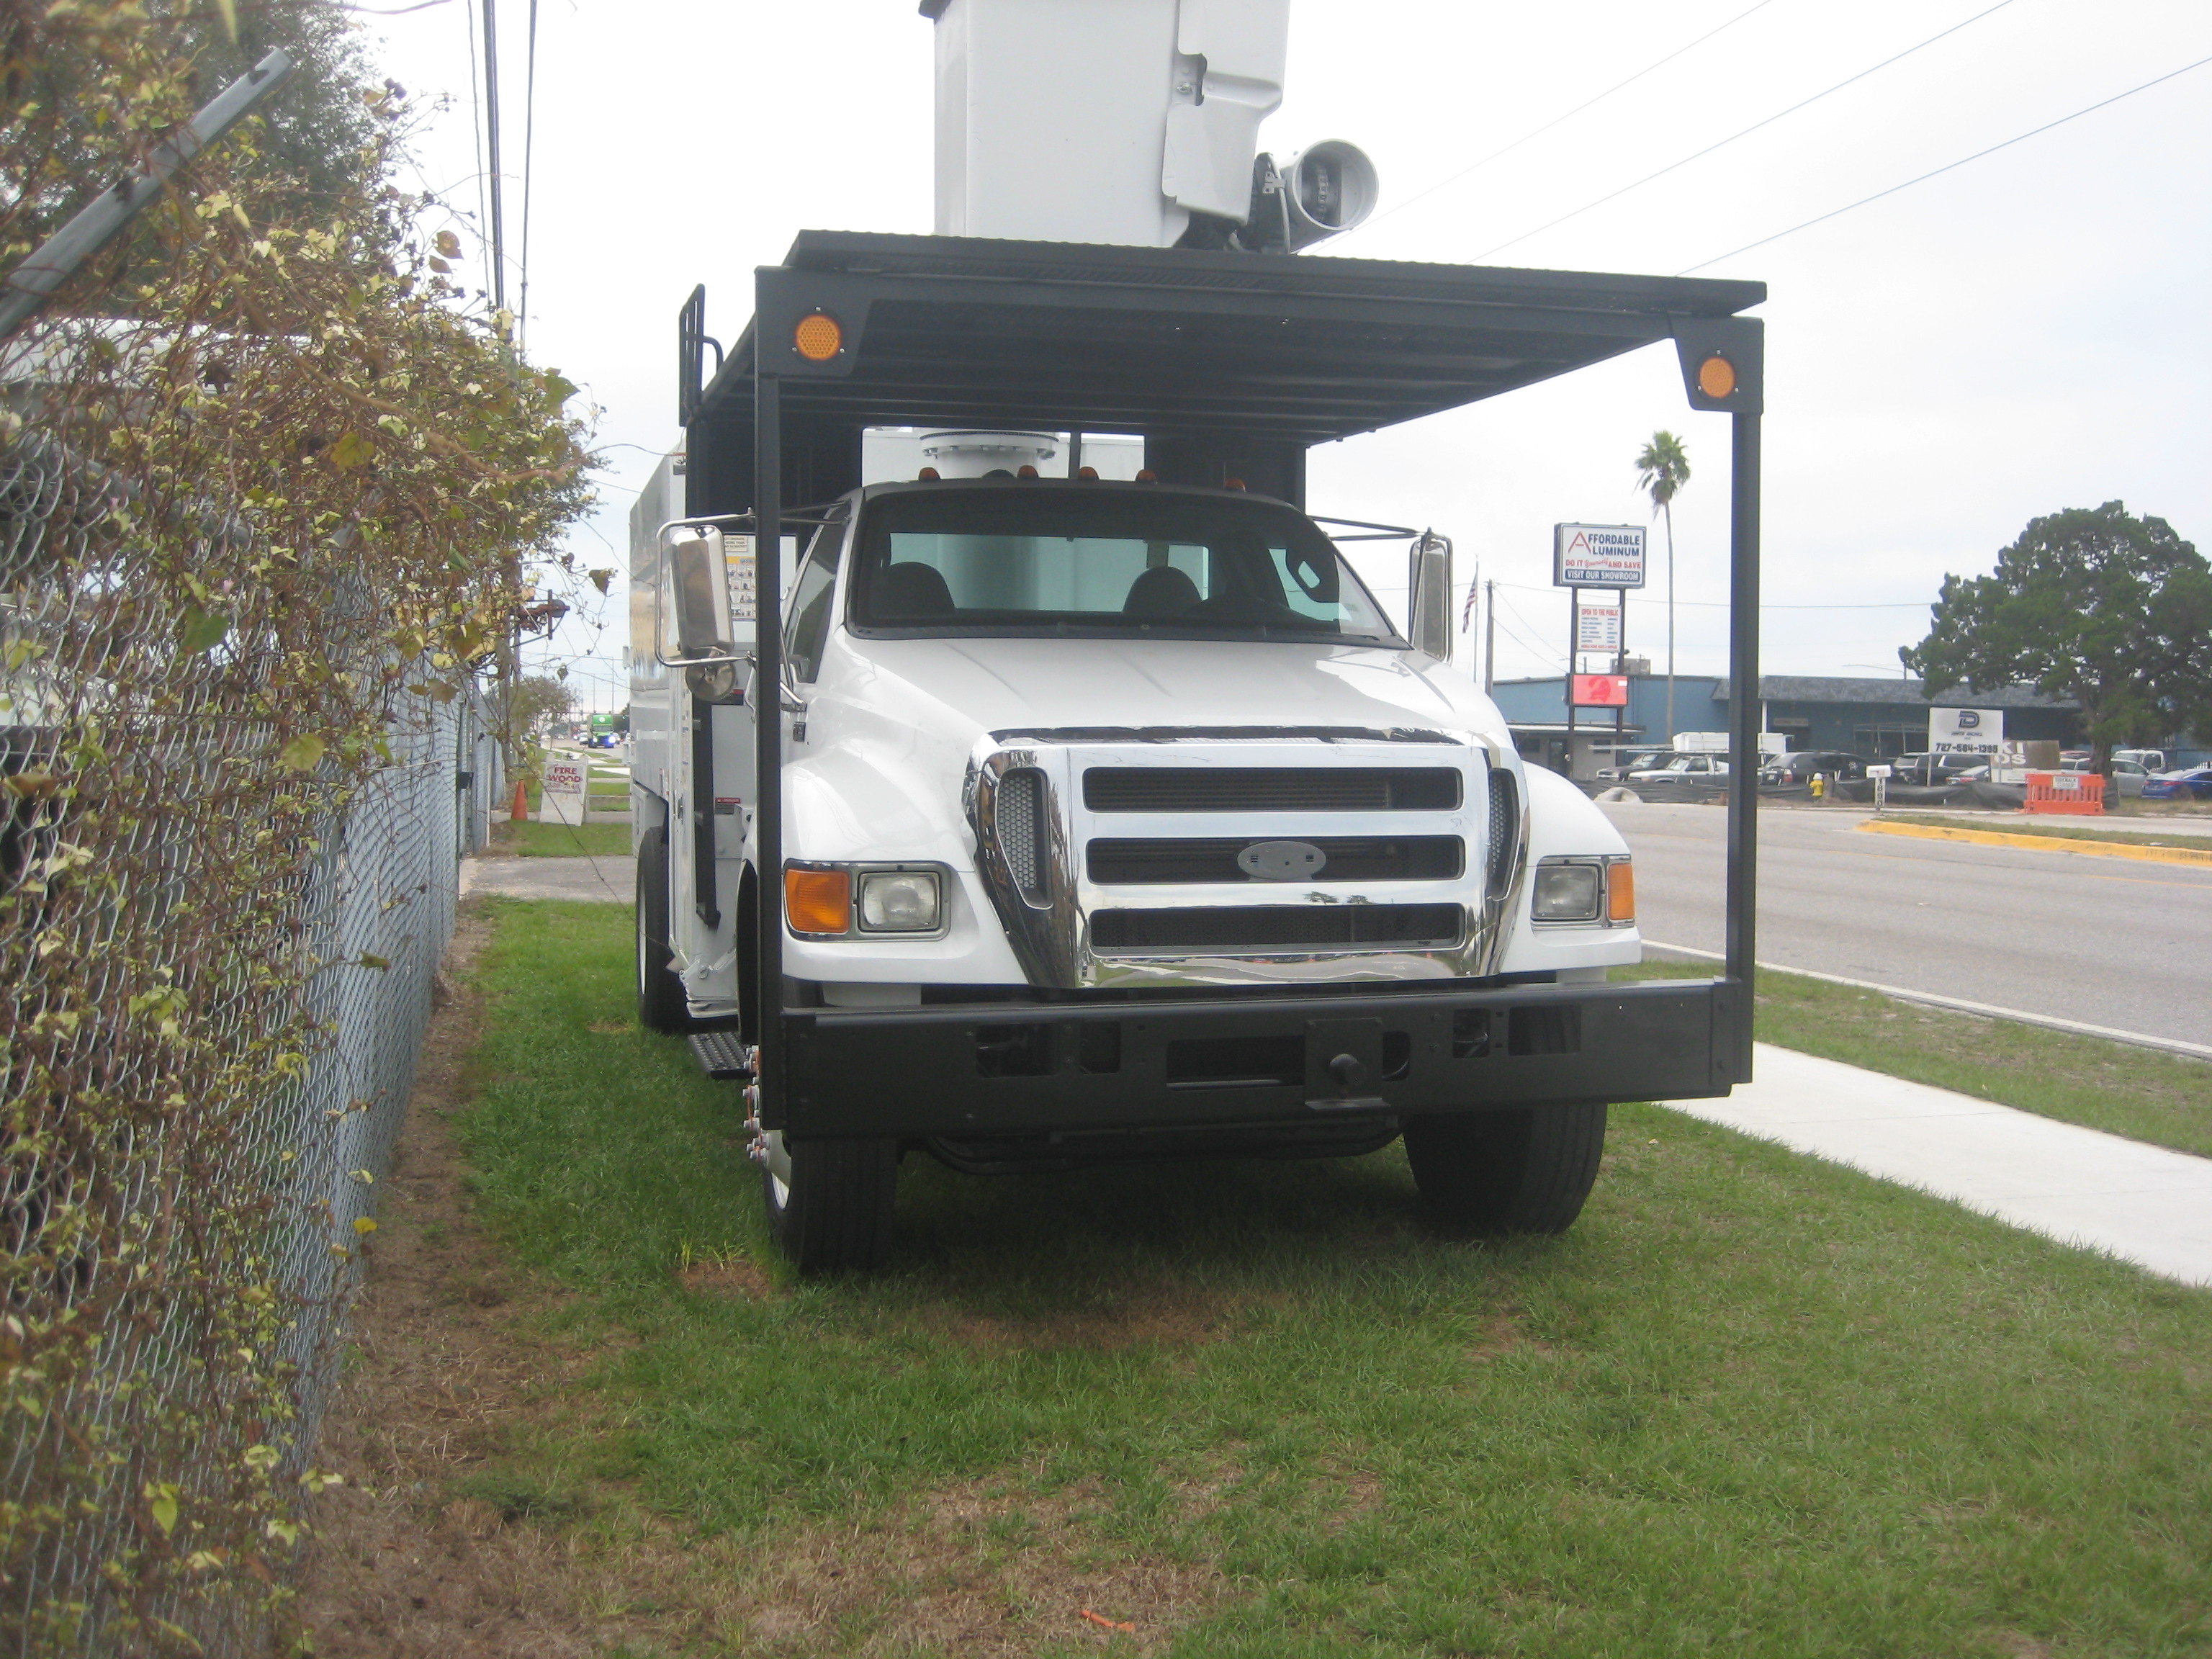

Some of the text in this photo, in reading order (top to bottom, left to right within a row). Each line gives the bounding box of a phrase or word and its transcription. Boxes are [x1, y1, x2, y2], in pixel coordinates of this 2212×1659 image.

[1568, 531, 1640, 553] AFFORDABLE
[1567, 570, 1639, 581] VISIT OUR SHOWROOM
